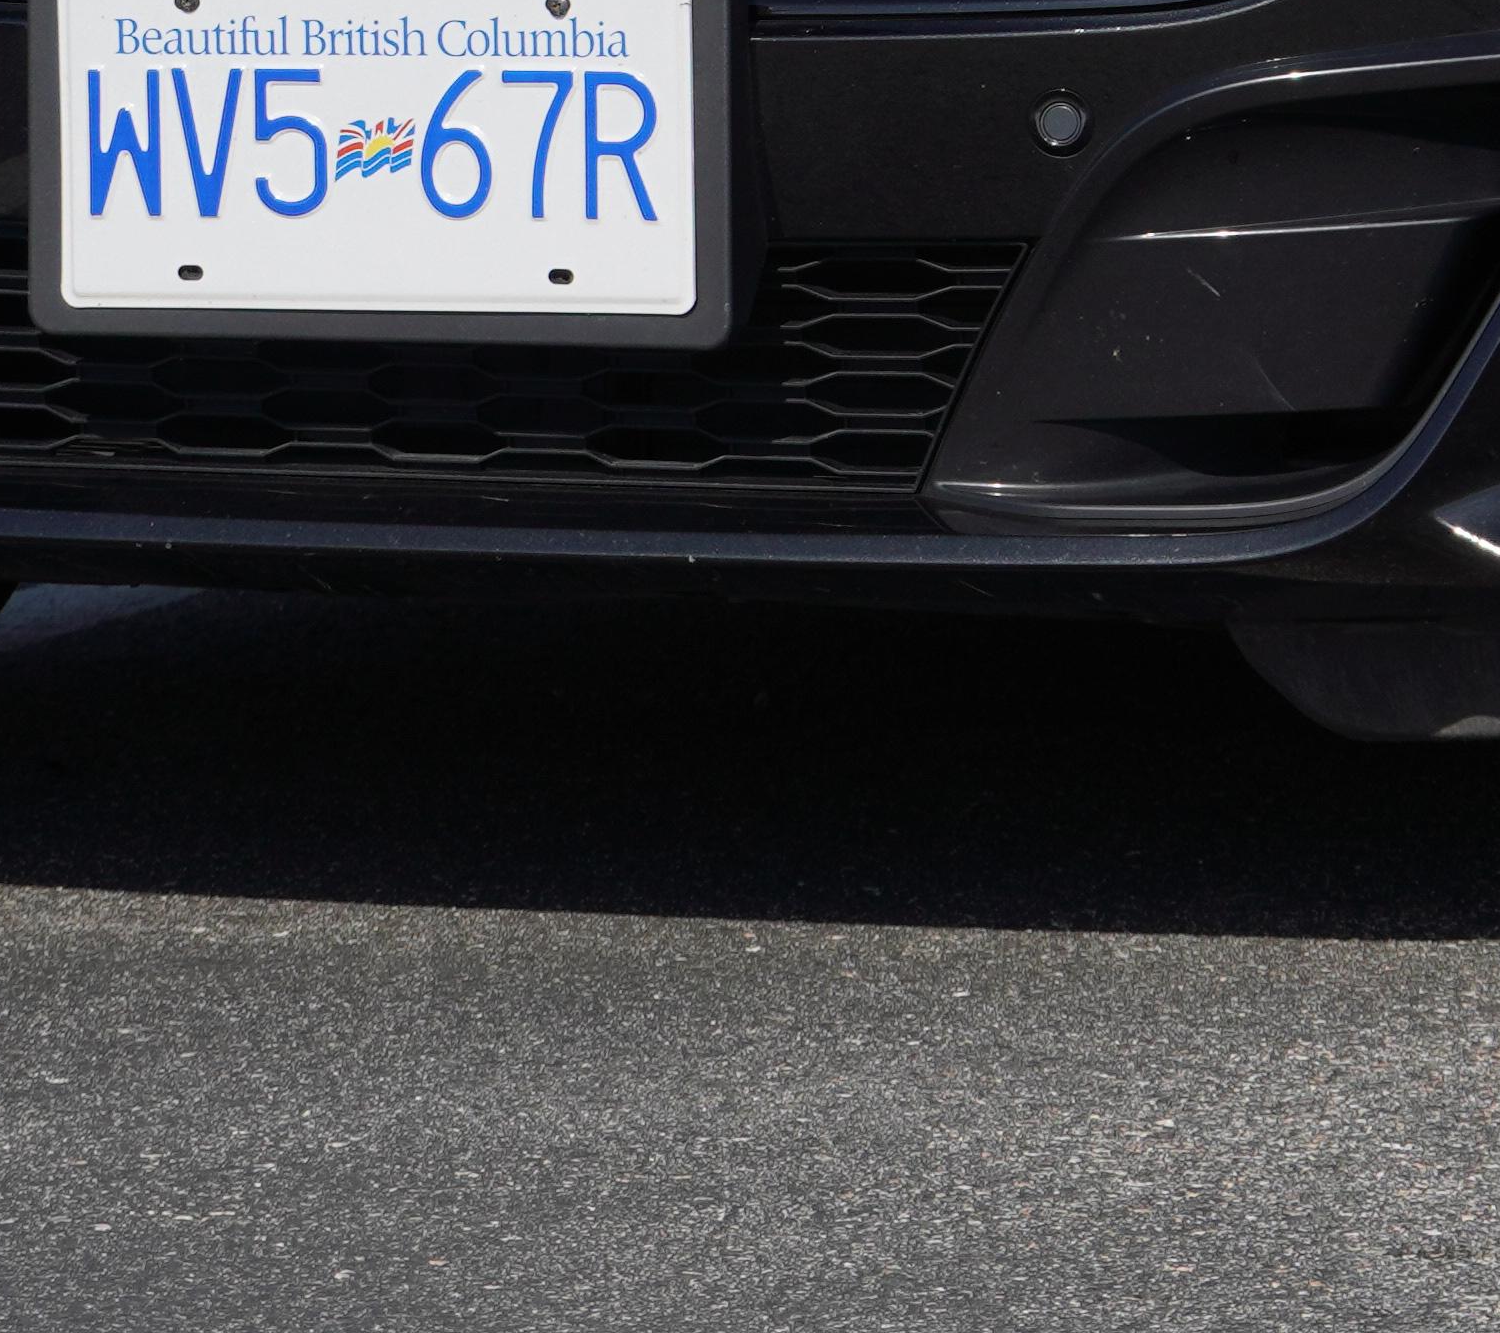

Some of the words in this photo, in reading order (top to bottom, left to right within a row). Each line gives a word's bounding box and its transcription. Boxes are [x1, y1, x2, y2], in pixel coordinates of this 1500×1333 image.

[117, 17, 286, 54] Beautiful
[304, 18, 423, 54] British
[437, 18, 627, 56] Columbia
[88, 68, 328, 217] WV5
[420, 70, 656, 221] 67R
